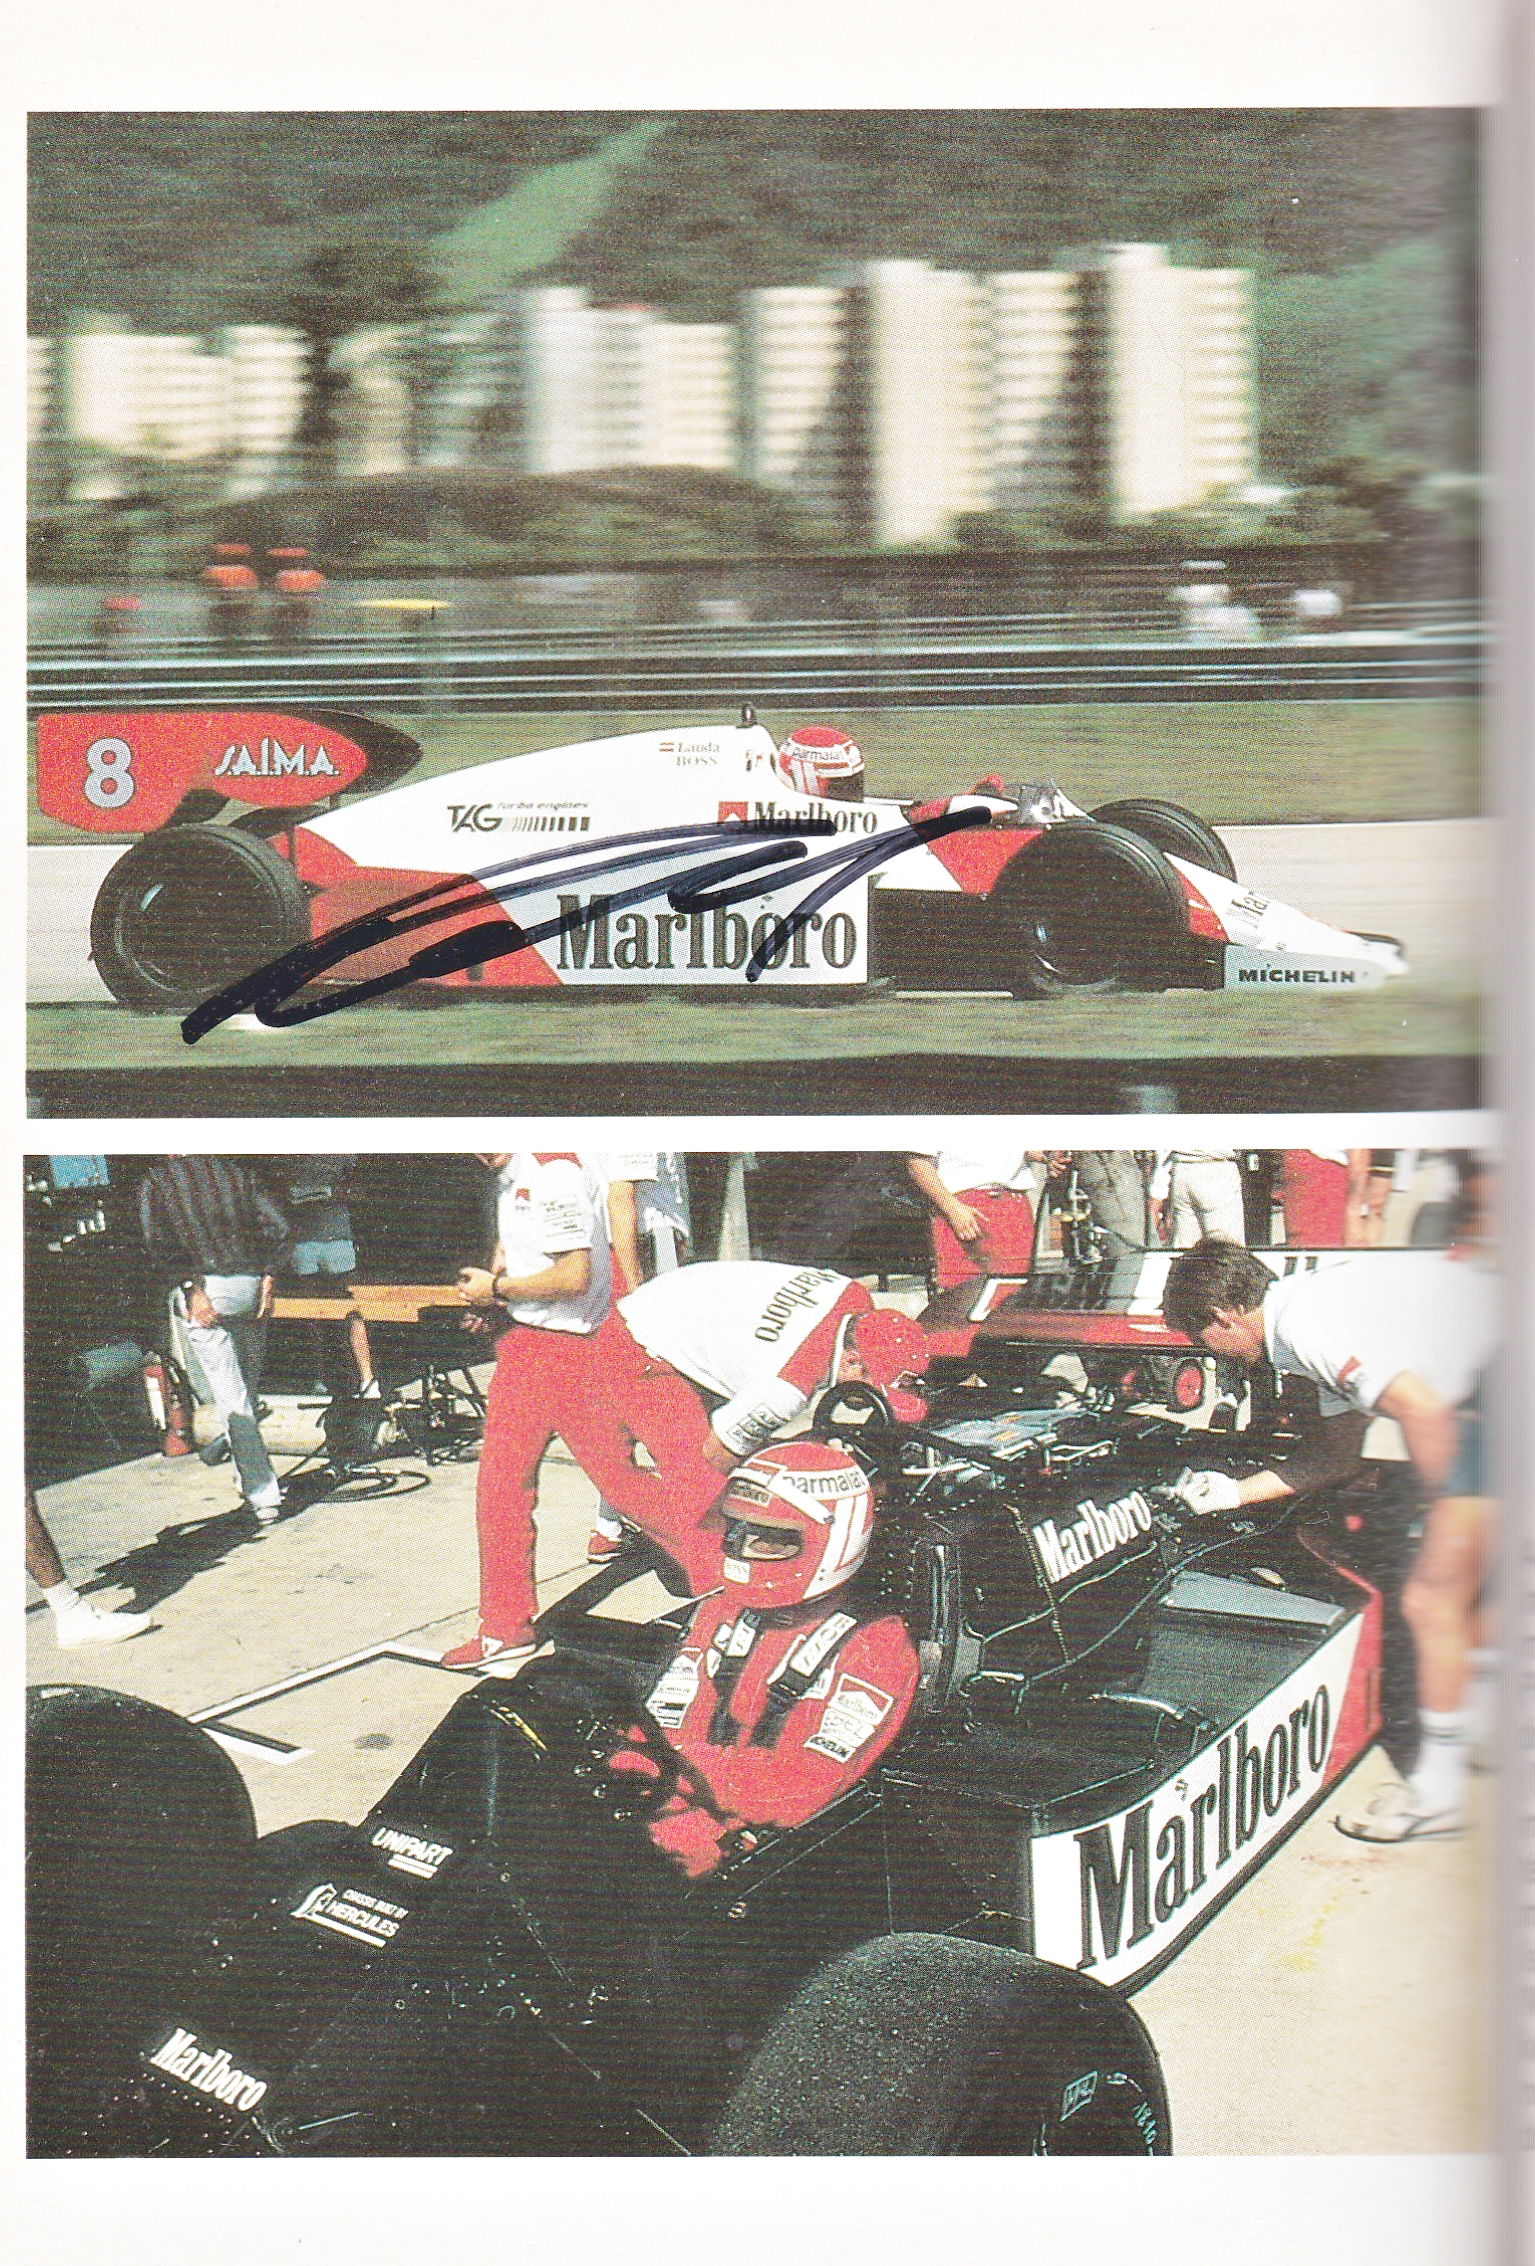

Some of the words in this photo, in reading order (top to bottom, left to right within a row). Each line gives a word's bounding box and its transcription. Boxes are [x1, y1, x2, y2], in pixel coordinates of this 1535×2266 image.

[84, 737, 135, 809] 8
[677, 741, 720, 753] Lauda
[447, 803, 503, 832] TAG
[754, 801, 878, 834] Marlboro
[556, 893, 858, 971] Marlboro
[1237, 968, 1356, 983] MICHELIN
[754, 1270, 841, 1343] Marlboro
[1032, 1490, 1153, 1584] Marlboro
[371, 1826, 454, 1866] UNIPART
[1073, 1683, 1331, 1971] Marlboro
[323, 1899, 400, 1939] HERCULES
[150, 2027, 268, 2112] Marlboro
